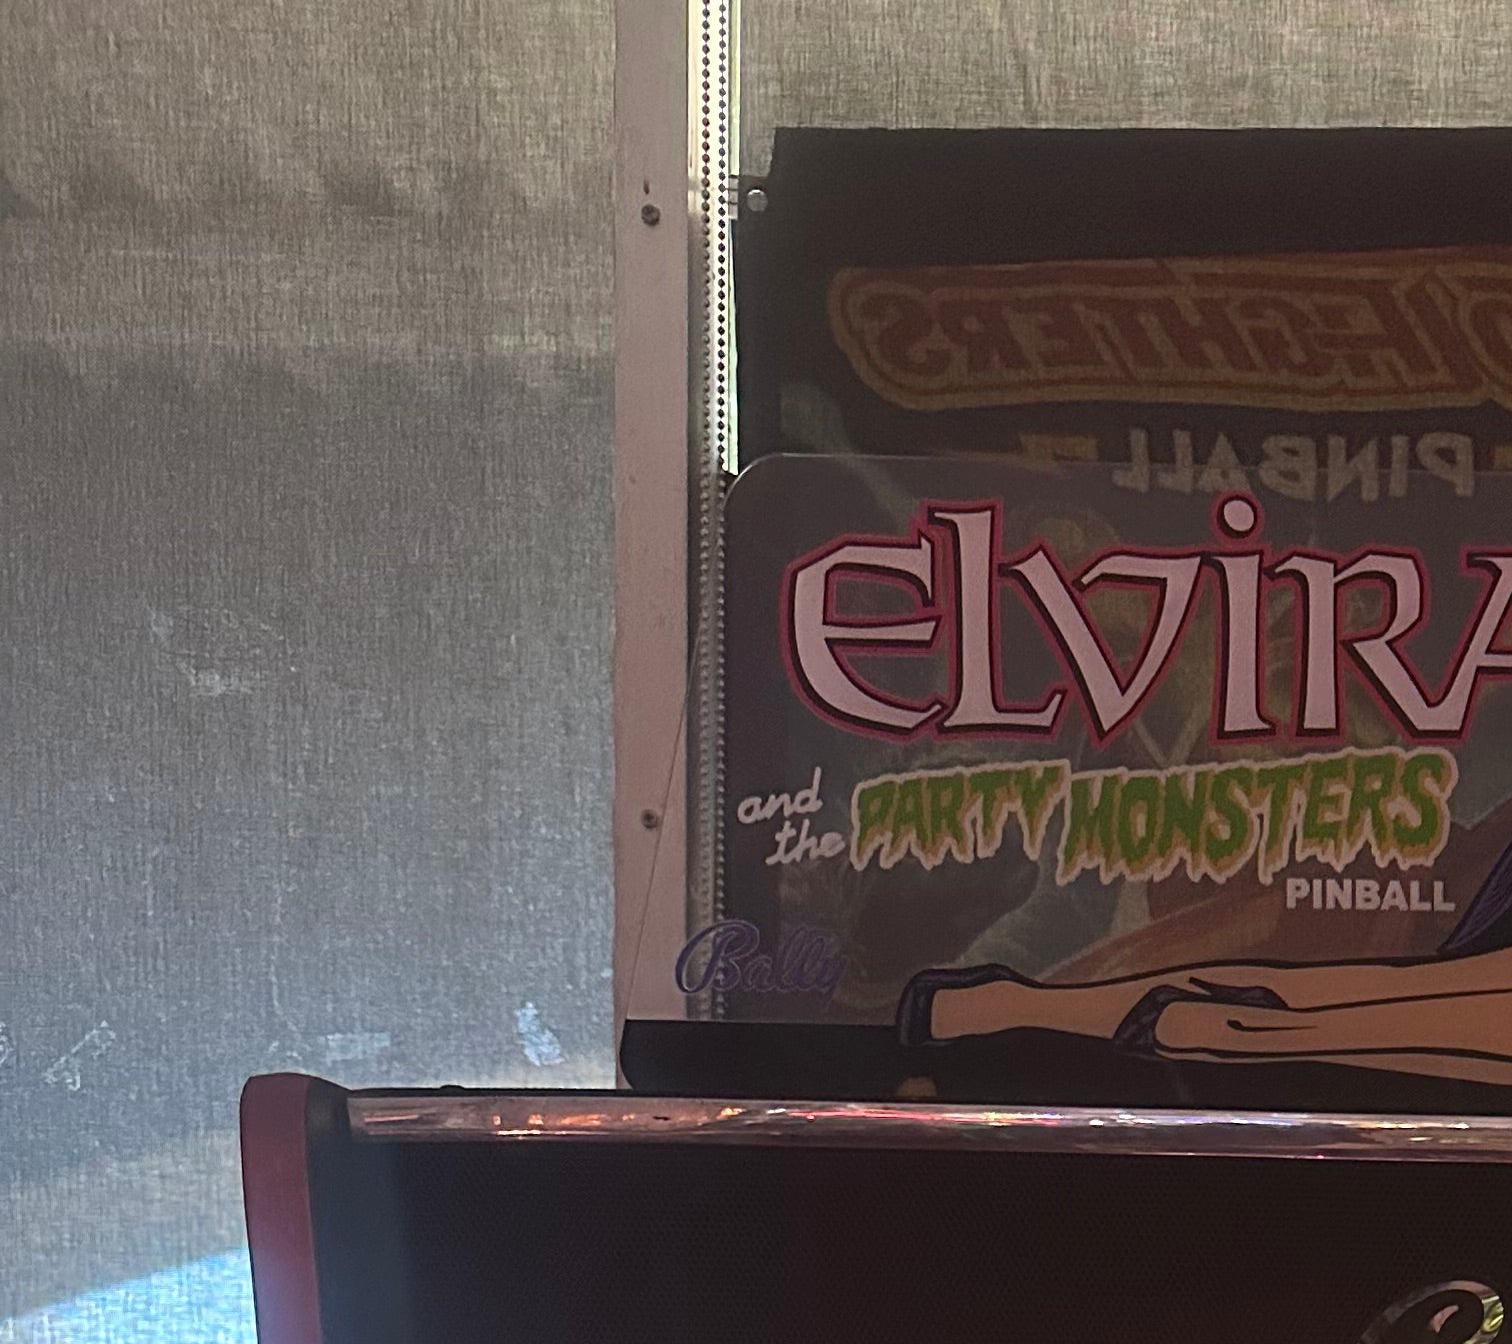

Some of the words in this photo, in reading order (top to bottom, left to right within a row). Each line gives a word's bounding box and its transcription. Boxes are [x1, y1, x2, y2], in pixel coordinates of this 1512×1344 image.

[738, 767, 822, 822] and
[851, 760, 1070, 871] PARTY
[1057, 747, 1458, 885] MONSTERS
[766, 822, 846, 866] the
[1286, 878, 1455, 913] PINBALL
